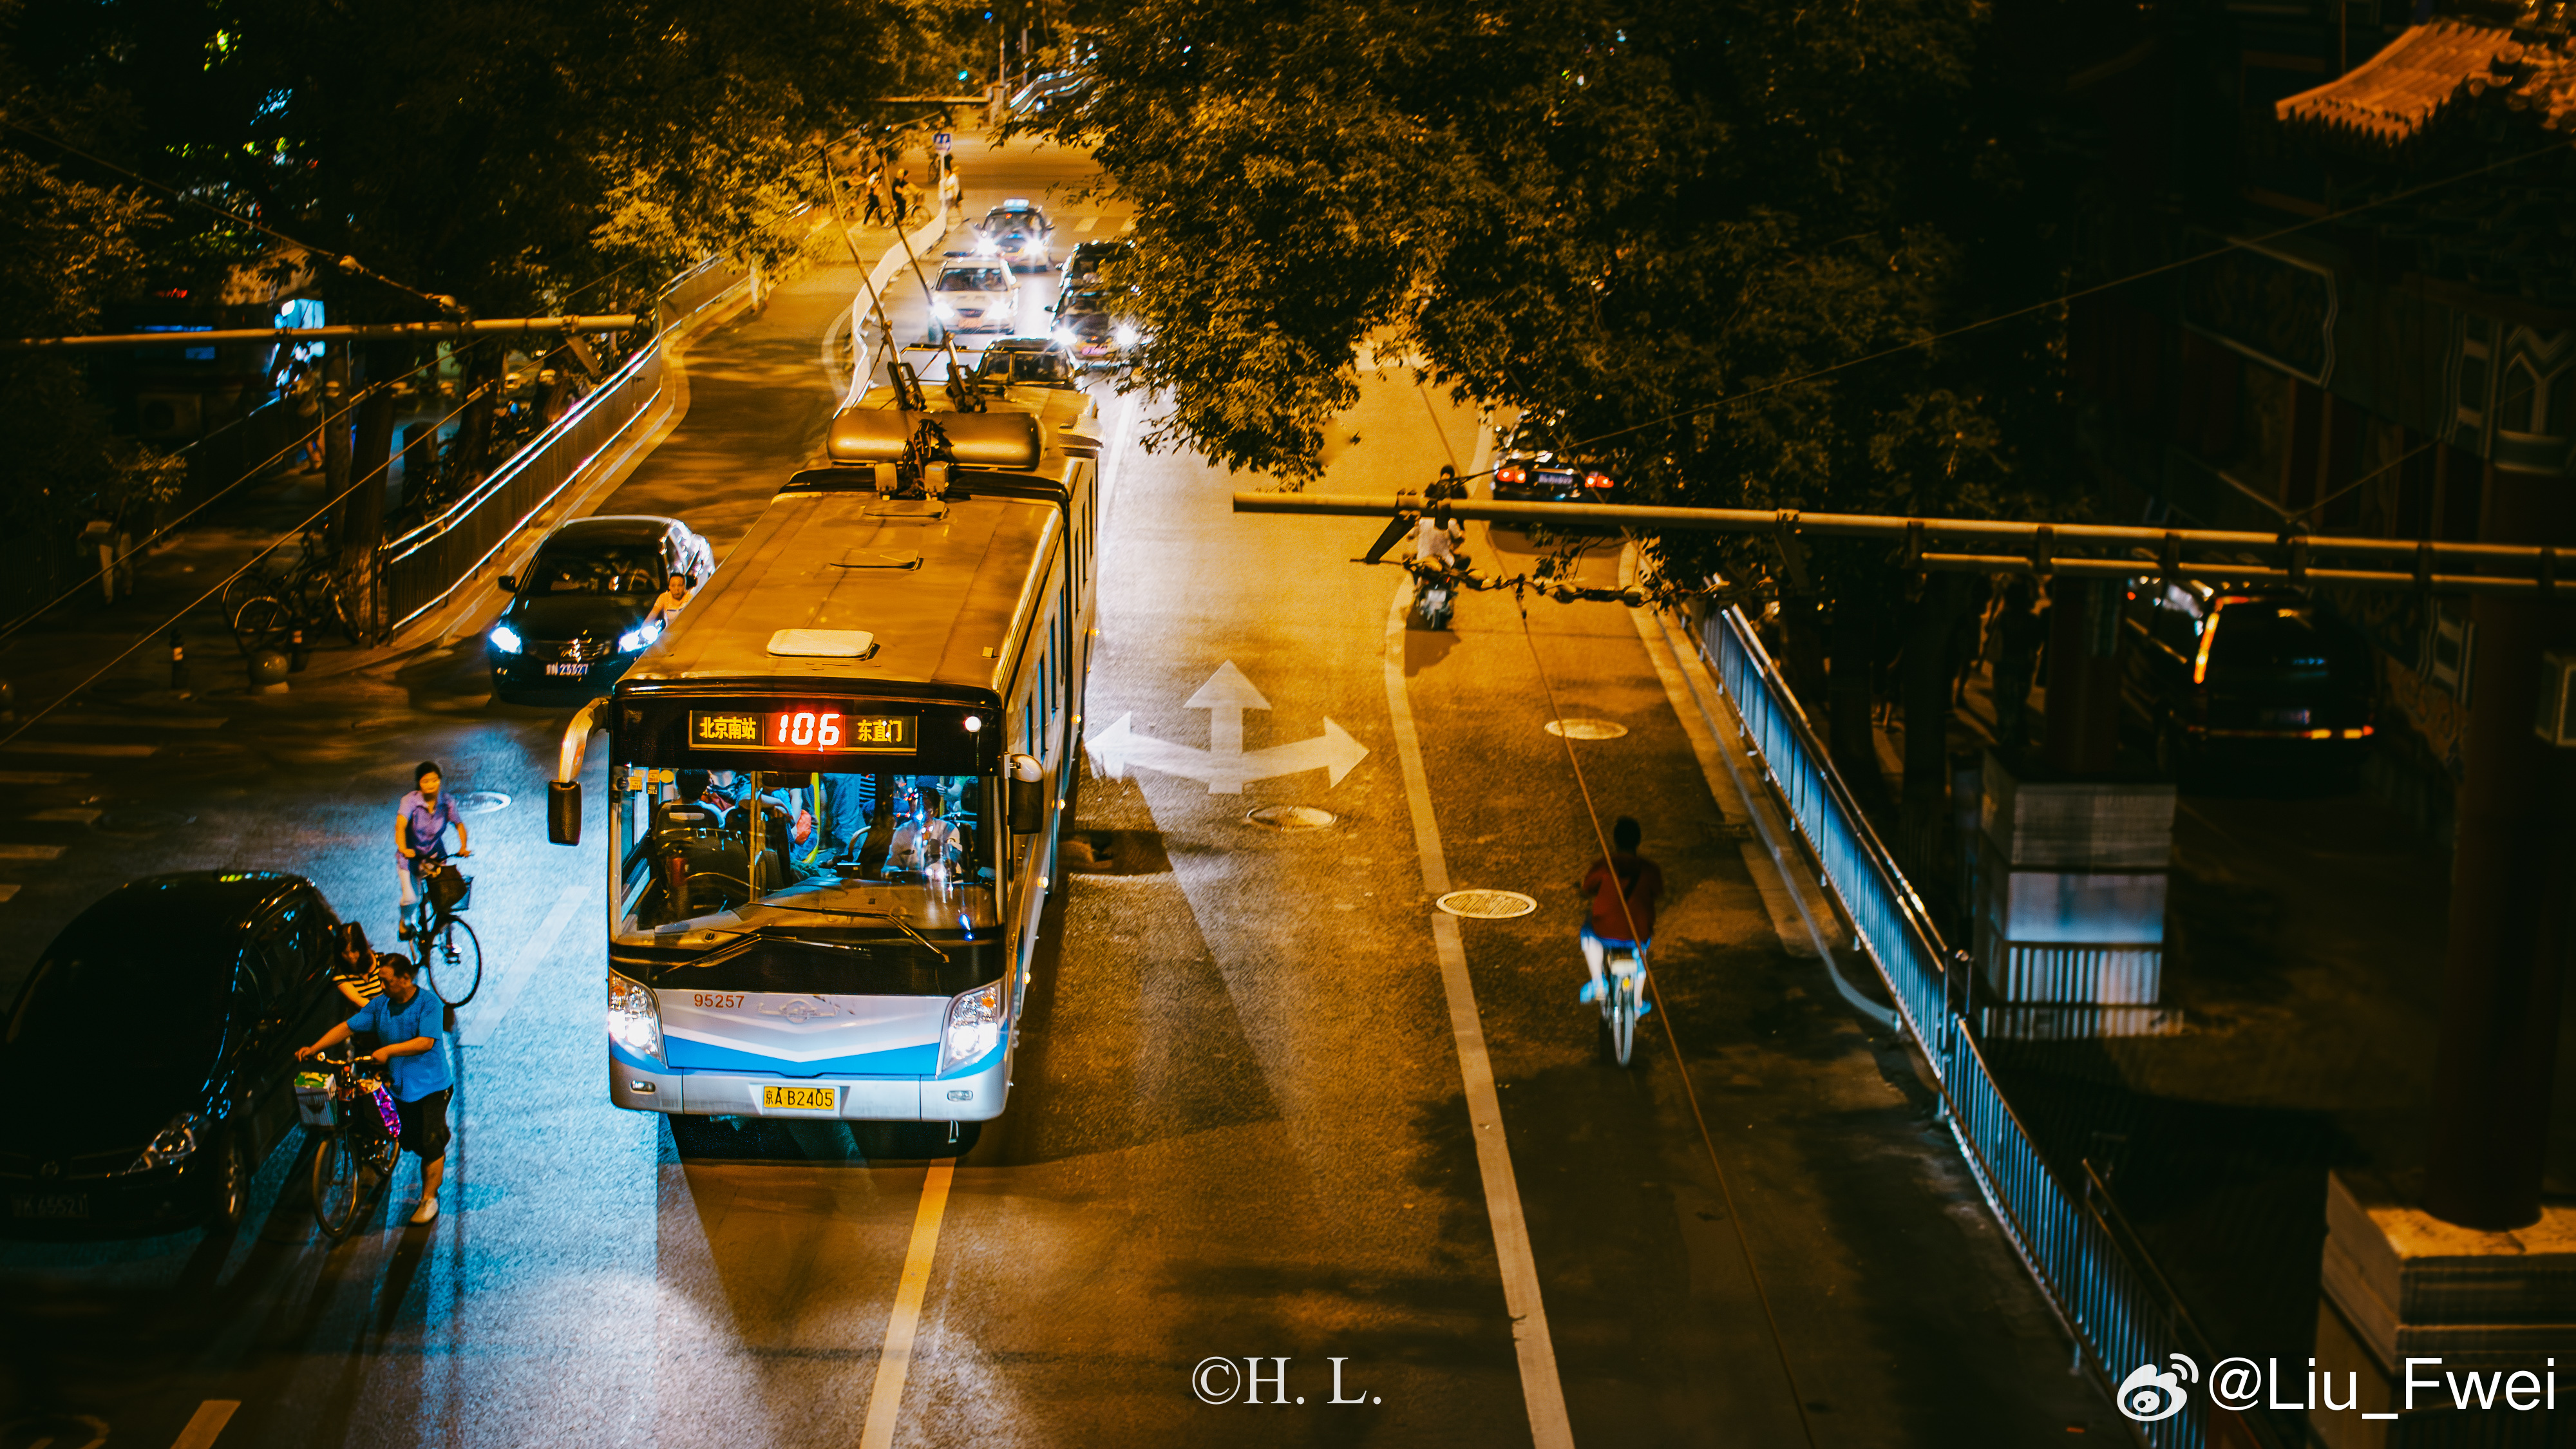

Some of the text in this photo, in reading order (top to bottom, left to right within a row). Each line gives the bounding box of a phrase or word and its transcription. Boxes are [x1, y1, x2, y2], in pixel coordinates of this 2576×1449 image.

[699, 712, 902, 745] 北京南站 106 东直门
[694, 994, 744, 1009] 95257
